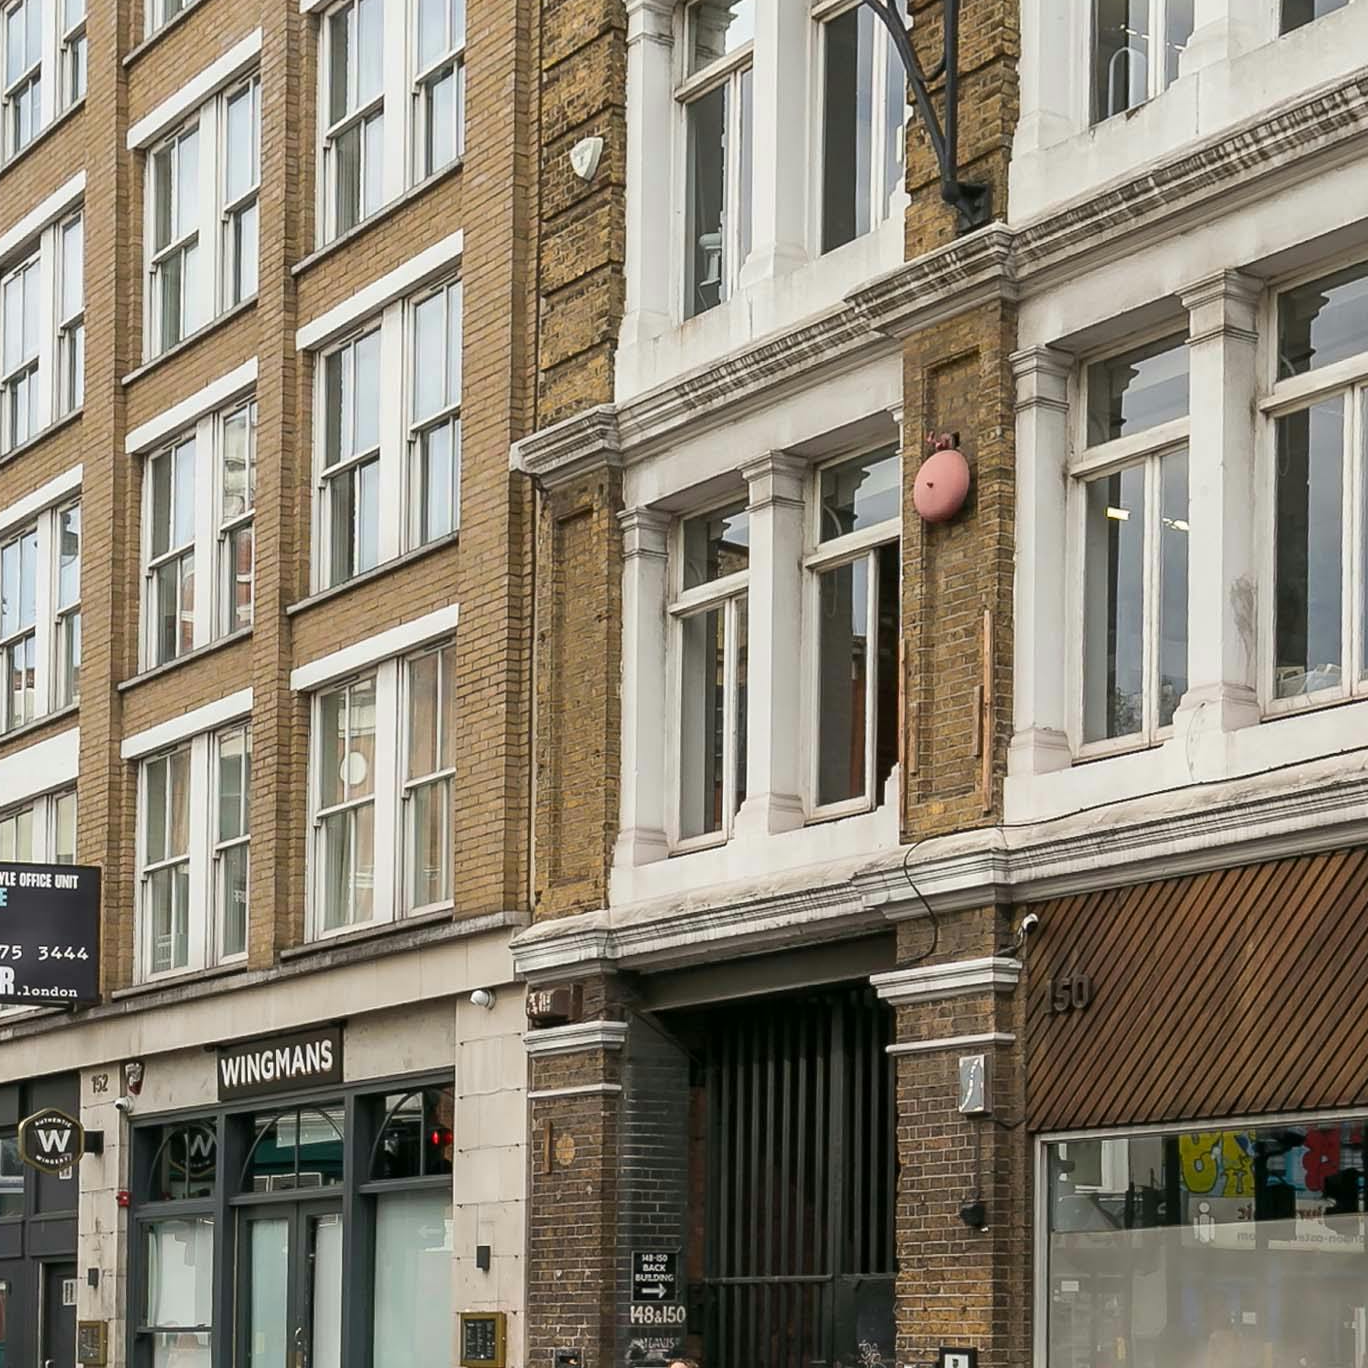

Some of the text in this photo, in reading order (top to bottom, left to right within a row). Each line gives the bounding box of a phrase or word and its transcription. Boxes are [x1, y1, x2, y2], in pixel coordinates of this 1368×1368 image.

[19, 872, 52, 888] OFFICE
[55, 874, 79, 889] UNIT
[38, 946, 88, 961] 3444
[1047, 975, 1090, 1013] 150
[221, 1039, 333, 1088] WINGMANS
[91, 1073, 109, 1093] 152
[35, 1118, 72, 1128] AUTHENTIC
[37, 1129, 72, 1153] W
[643, 1264, 666, 1272] BACK
[635, 1273, 674, 1282] BUILDING
[630, 1305, 686, 1324] 148&150
